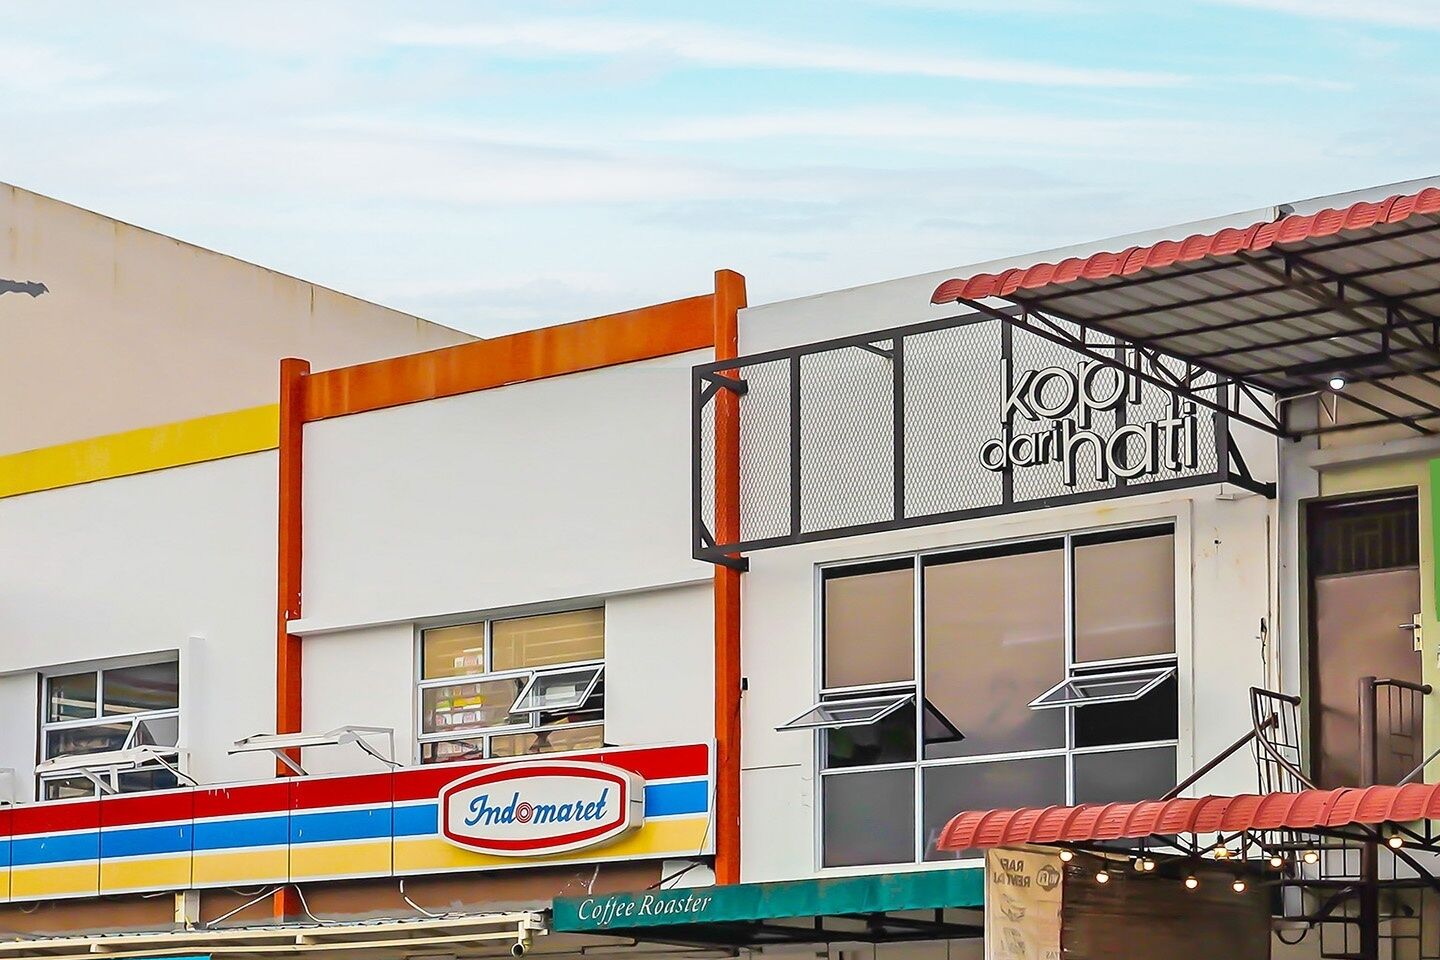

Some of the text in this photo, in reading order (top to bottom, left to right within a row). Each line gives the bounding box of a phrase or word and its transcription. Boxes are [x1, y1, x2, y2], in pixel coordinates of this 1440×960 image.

[464, 788, 609, 826] Indomaret
[578, 893, 712, 926] Coffee Roaster
